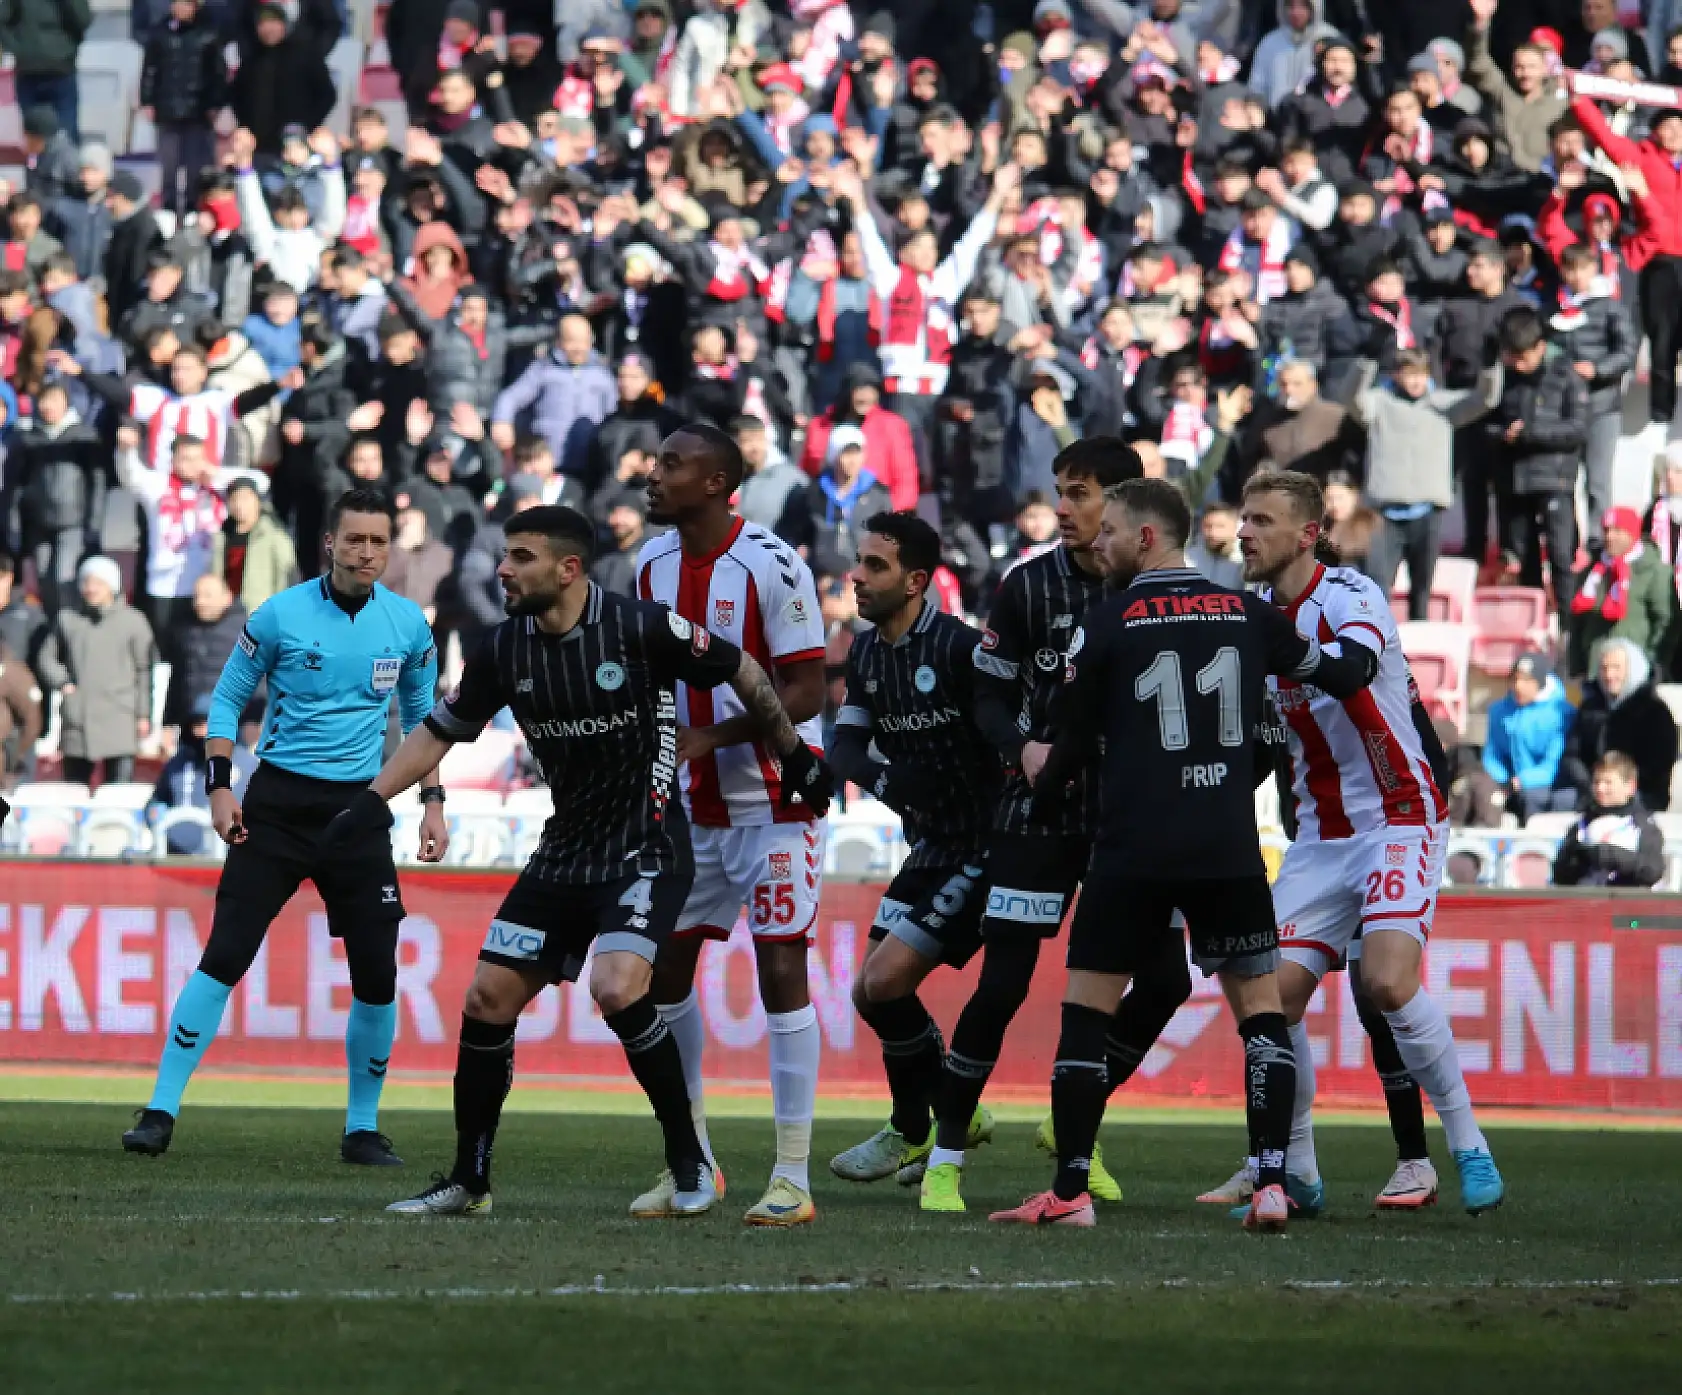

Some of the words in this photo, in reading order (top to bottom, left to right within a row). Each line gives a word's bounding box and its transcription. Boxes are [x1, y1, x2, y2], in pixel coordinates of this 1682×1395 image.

[1122, 593, 1246, 620] ATIKER
[1134, 646, 1244, 751] 11
[539, 704, 638, 739] TÜMOSAN
[1181, 762, 1228, 788] PRIP
[617, 878, 653, 914] 4
[753, 883, 797, 925] 55
[932, 874, 975, 916] 5
[987, 891, 1063, 917] onvo
[1366, 869, 1406, 906] 26
[0, 903, 447, 1044] KENLER
